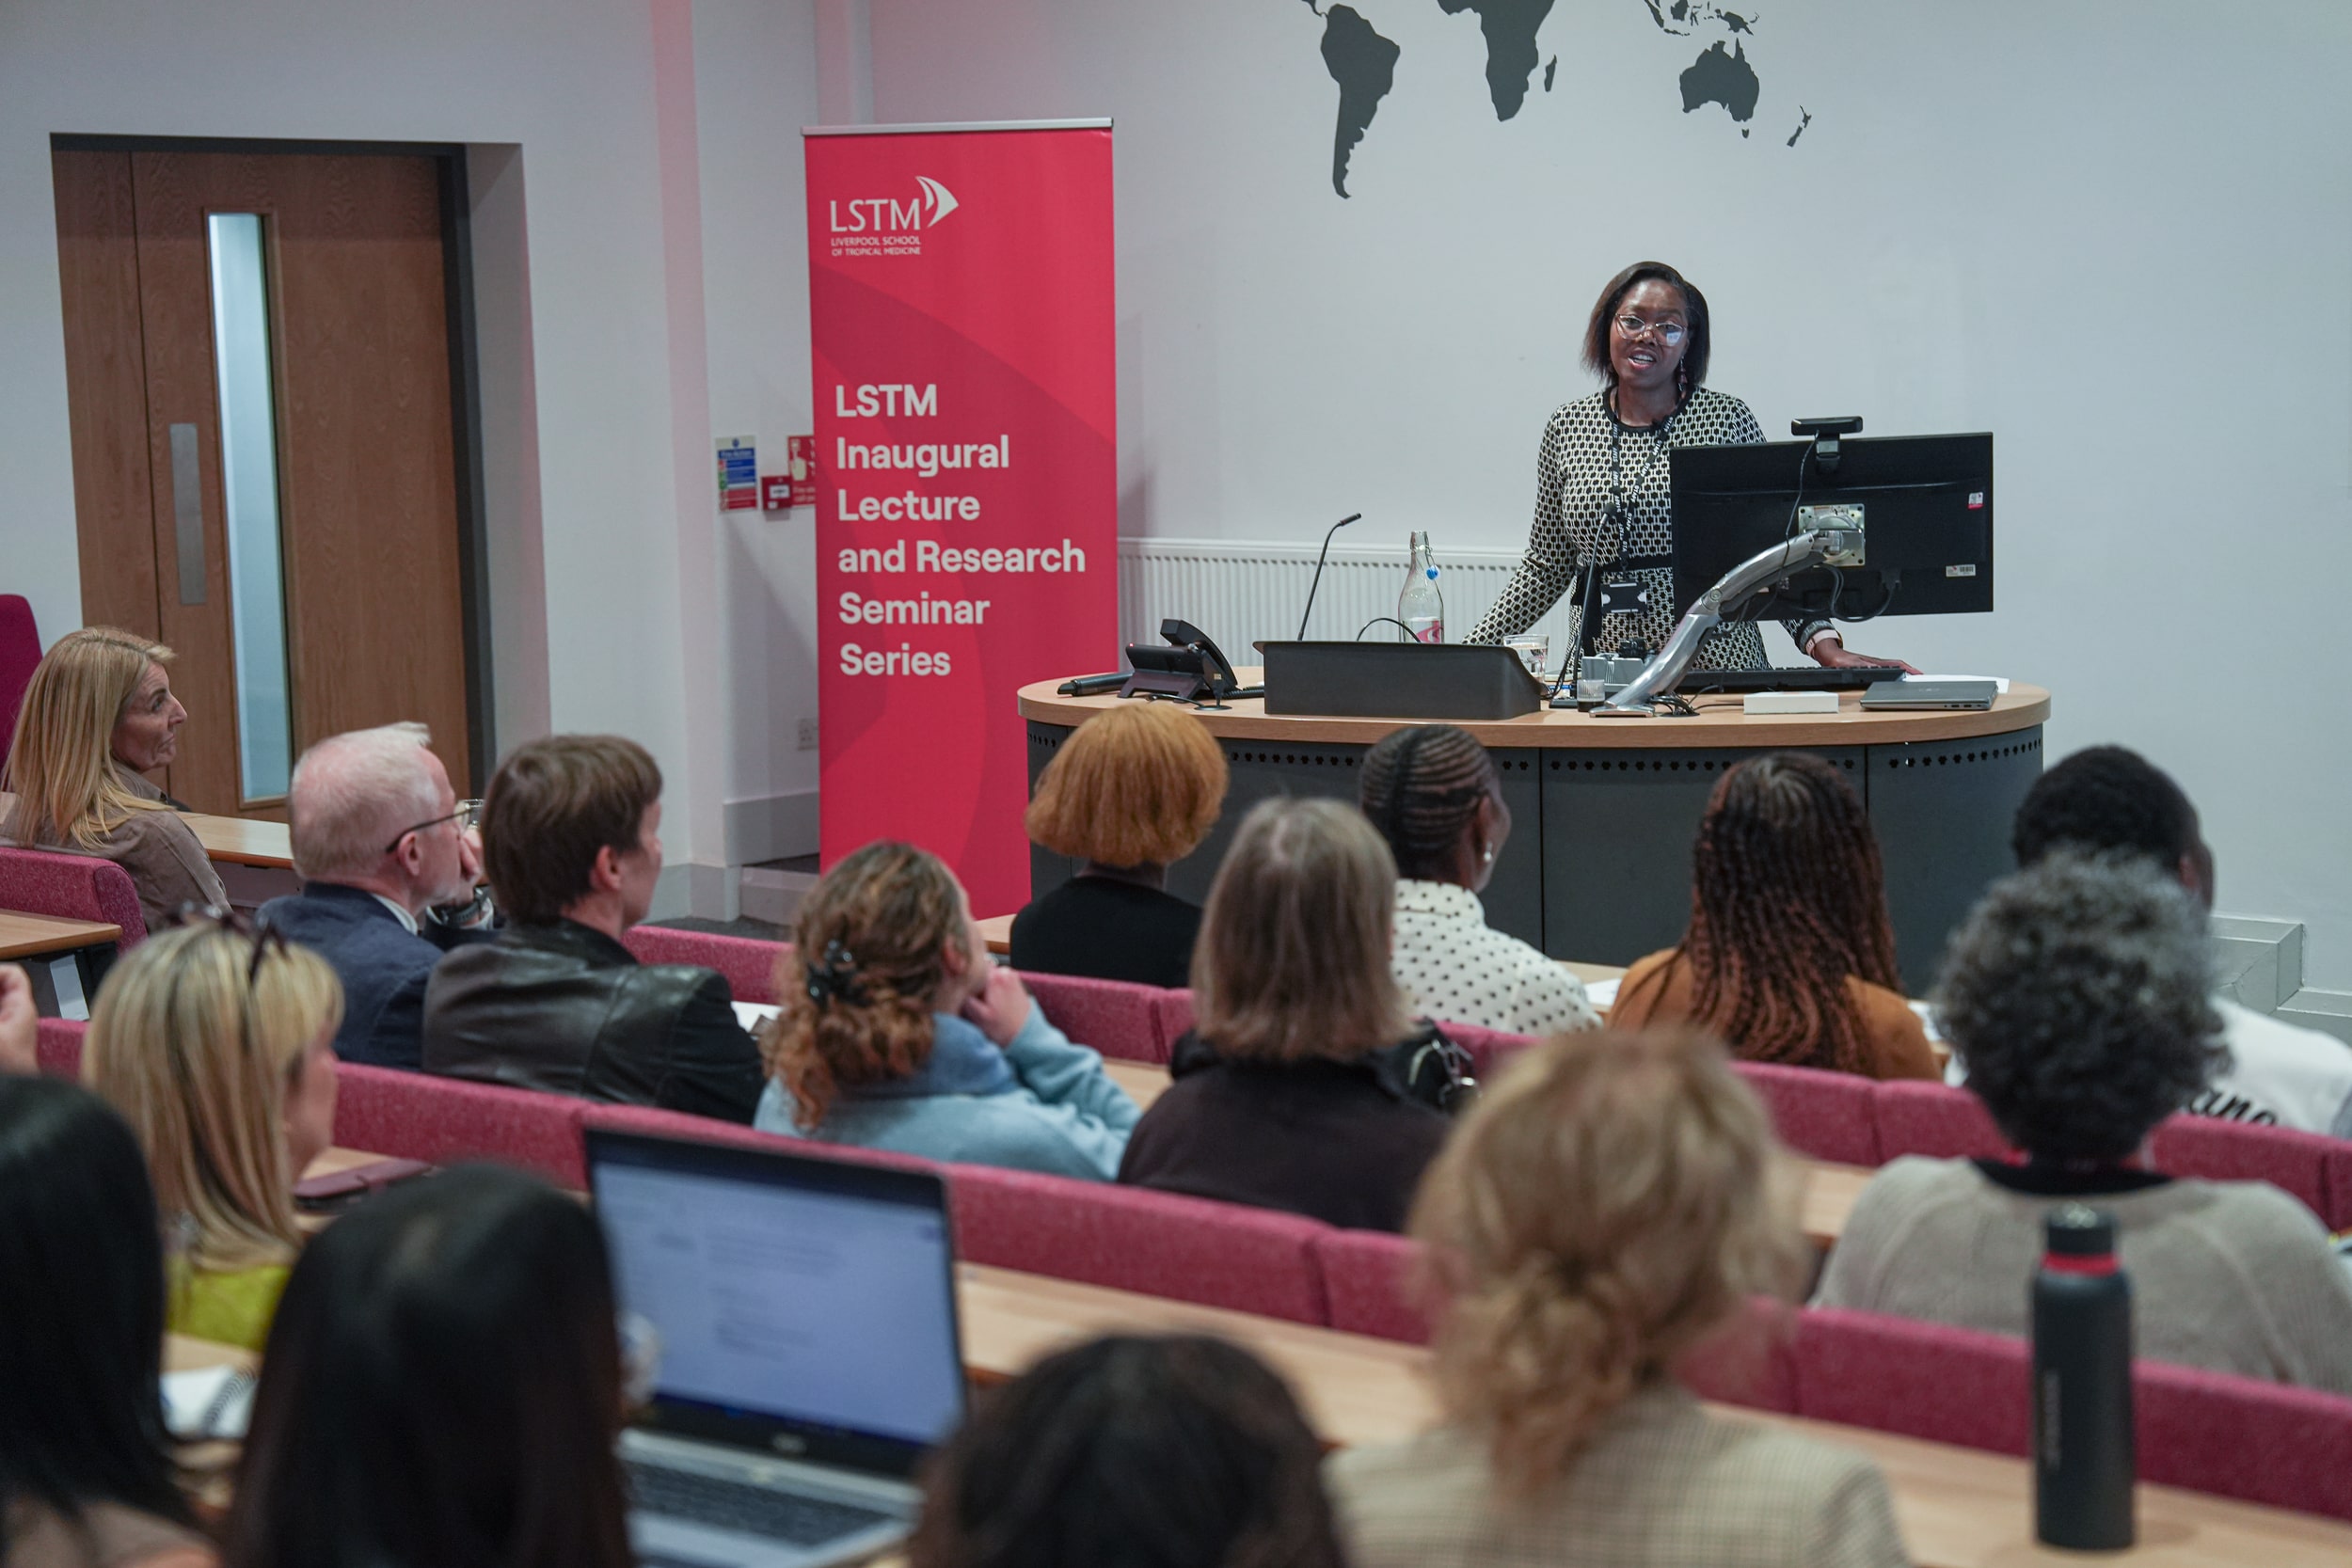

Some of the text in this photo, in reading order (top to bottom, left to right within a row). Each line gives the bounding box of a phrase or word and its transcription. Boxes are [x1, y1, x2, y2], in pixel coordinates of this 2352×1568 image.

[830, 198, 920, 232] LSTM
[831, 235, 921, 246] LIVERPOOL SCHOOL
[845, 247, 882, 256] TROPICAL
[883, 246, 921, 256] MEDICINE
[835, 384, 938, 418] LSTM
[836, 435, 1009, 477] Inaugural
[838, 489, 980, 521] Lecture
[838, 538, 1086, 573] and Research
[839, 591, 991, 625] Seminar
[840, 642, 951, 676] Series
